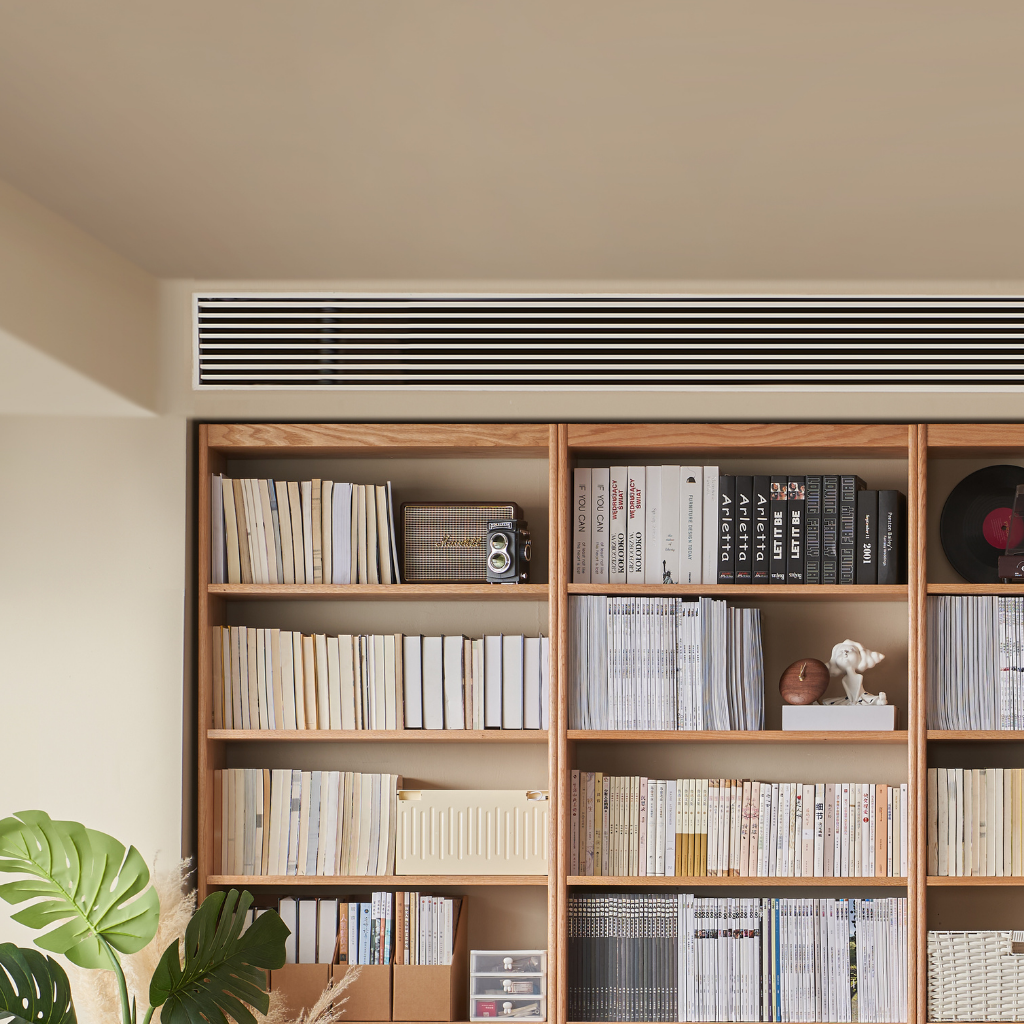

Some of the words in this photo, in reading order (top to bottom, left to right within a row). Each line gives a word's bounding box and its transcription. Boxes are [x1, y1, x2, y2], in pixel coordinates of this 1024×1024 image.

[578, 495, 586, 512] YOU
[578, 514, 586, 533] CAN
[722, 493, 732, 561] Arletta
[739, 493, 750, 561] Arletta
[756, 493, 767, 561] Arletta
[774, 511, 782, 526] BE
[791, 510, 800, 525] BE
[774, 527, 782, 537] IT
[791, 527, 800, 537] IT
[617, 533, 625, 574] KOŁODKO
[774, 539, 782, 559] LET
[791, 538, 800, 559] LET
[863, 543, 871, 564] 2001
[815, 803, 823, 820] 细节
